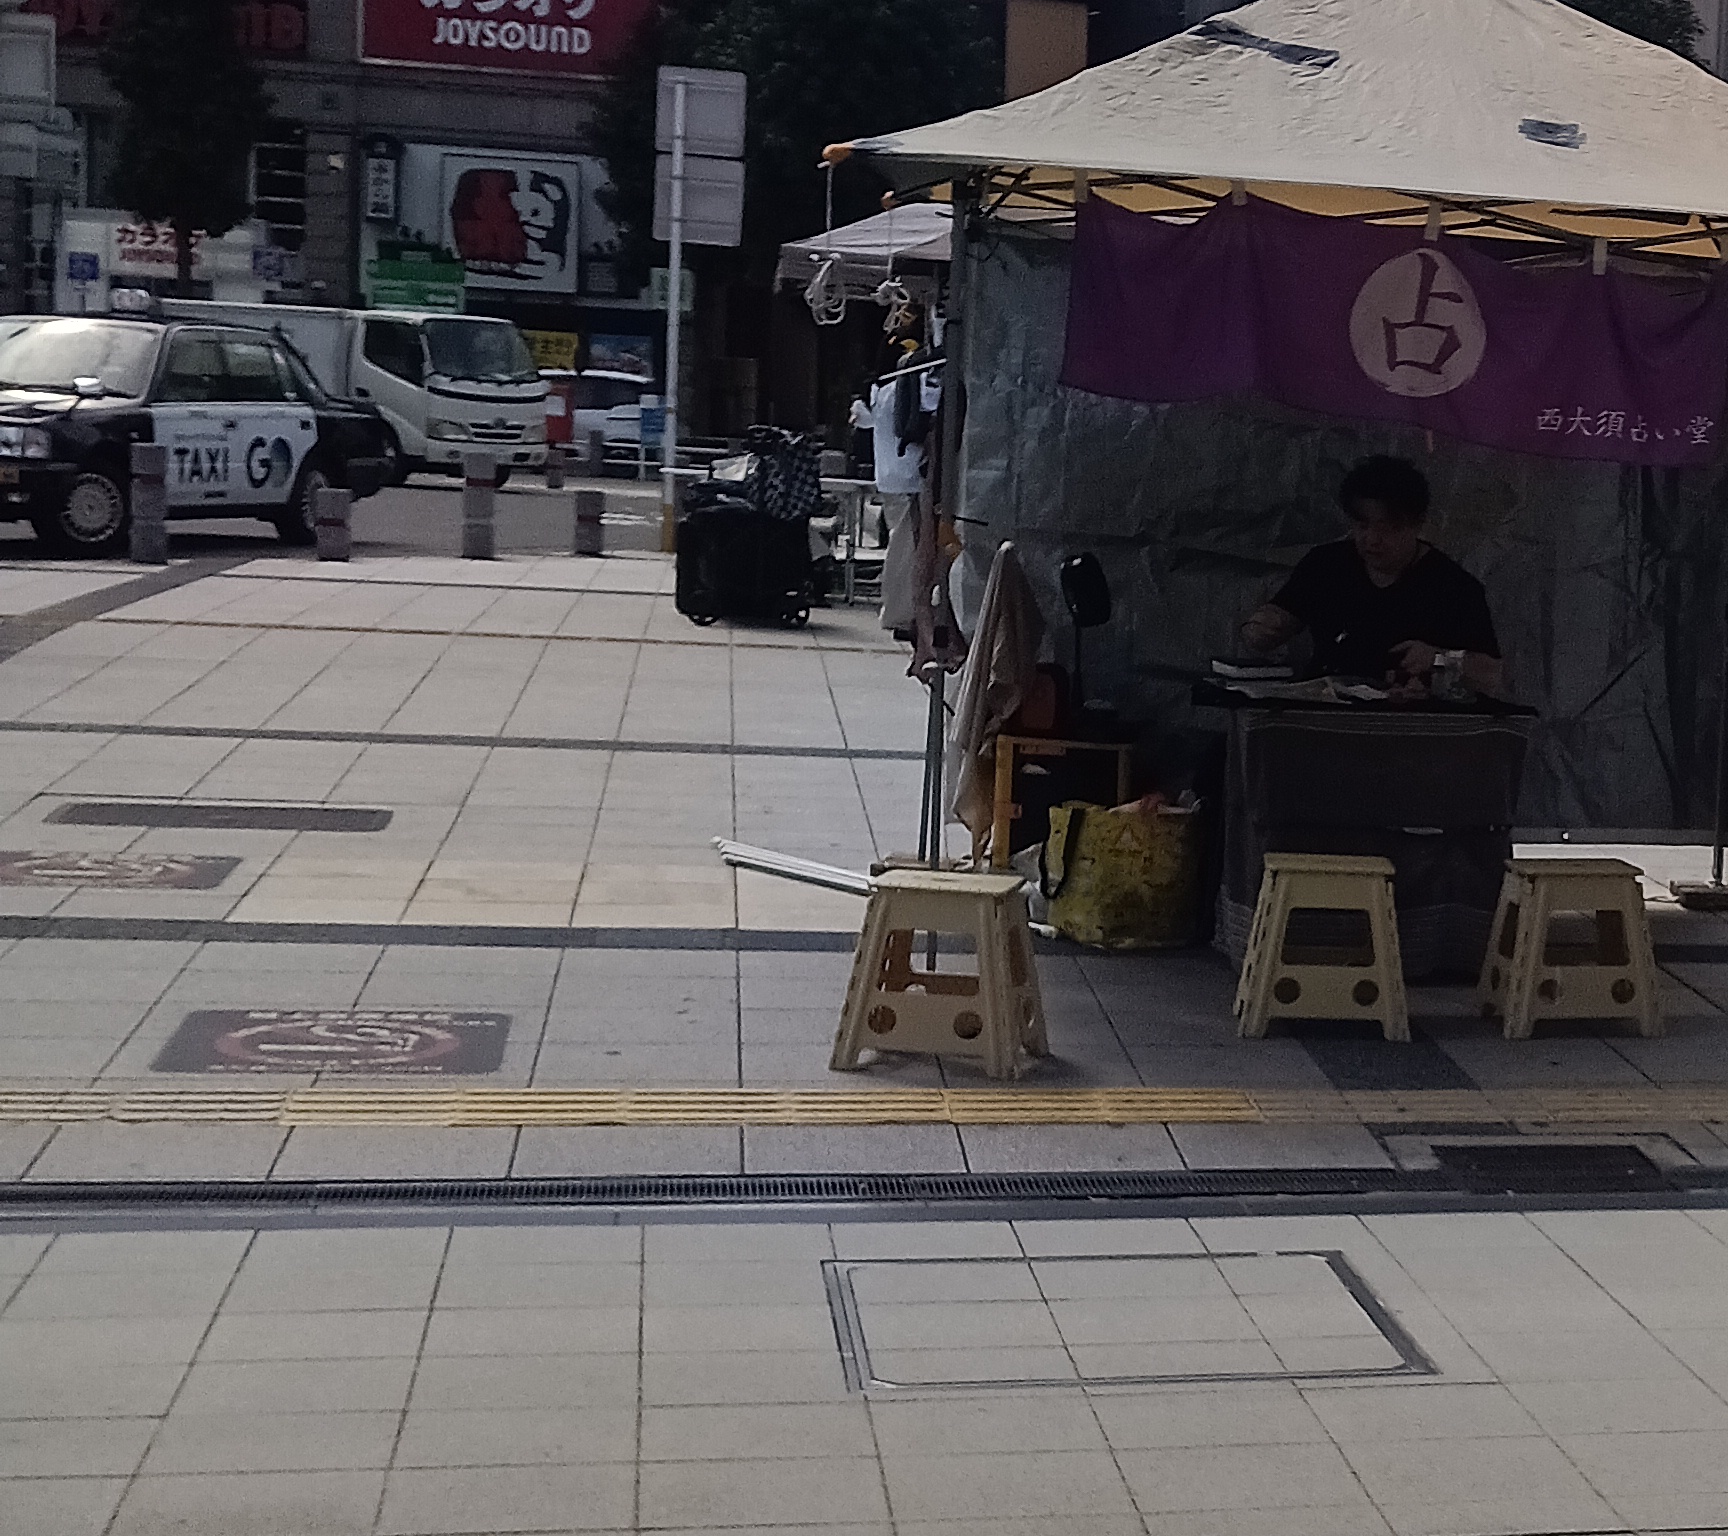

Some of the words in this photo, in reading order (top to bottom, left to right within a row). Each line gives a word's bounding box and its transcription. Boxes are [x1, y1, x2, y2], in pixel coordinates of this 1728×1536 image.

[432, 16, 592, 54] JOYSOUND
[1380, 249, 1463, 376] 占
[1536, 406, 1715, 445] 西大須占い堂
[173, 447, 230, 484] TAXI
[246, 435, 293, 489] GO
